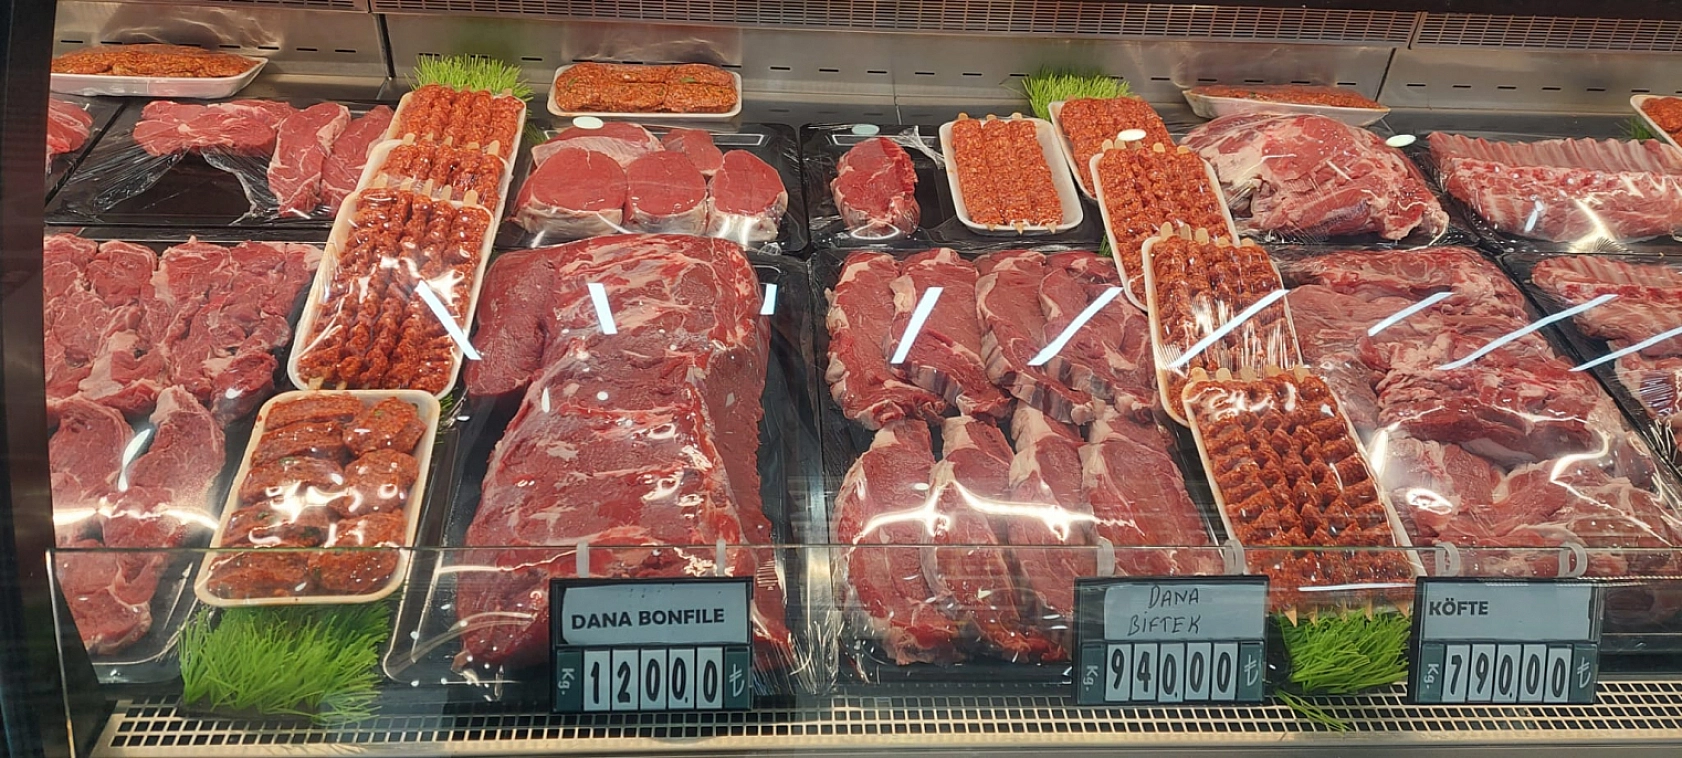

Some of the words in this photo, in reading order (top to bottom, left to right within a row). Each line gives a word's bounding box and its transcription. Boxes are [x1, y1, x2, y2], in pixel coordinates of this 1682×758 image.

[1148, 584, 1199, 609] DANA
[1429, 597, 1489, 616] KÖFTE
[571, 611, 632, 630] DANA
[638, 608, 725, 626] BONFILE
